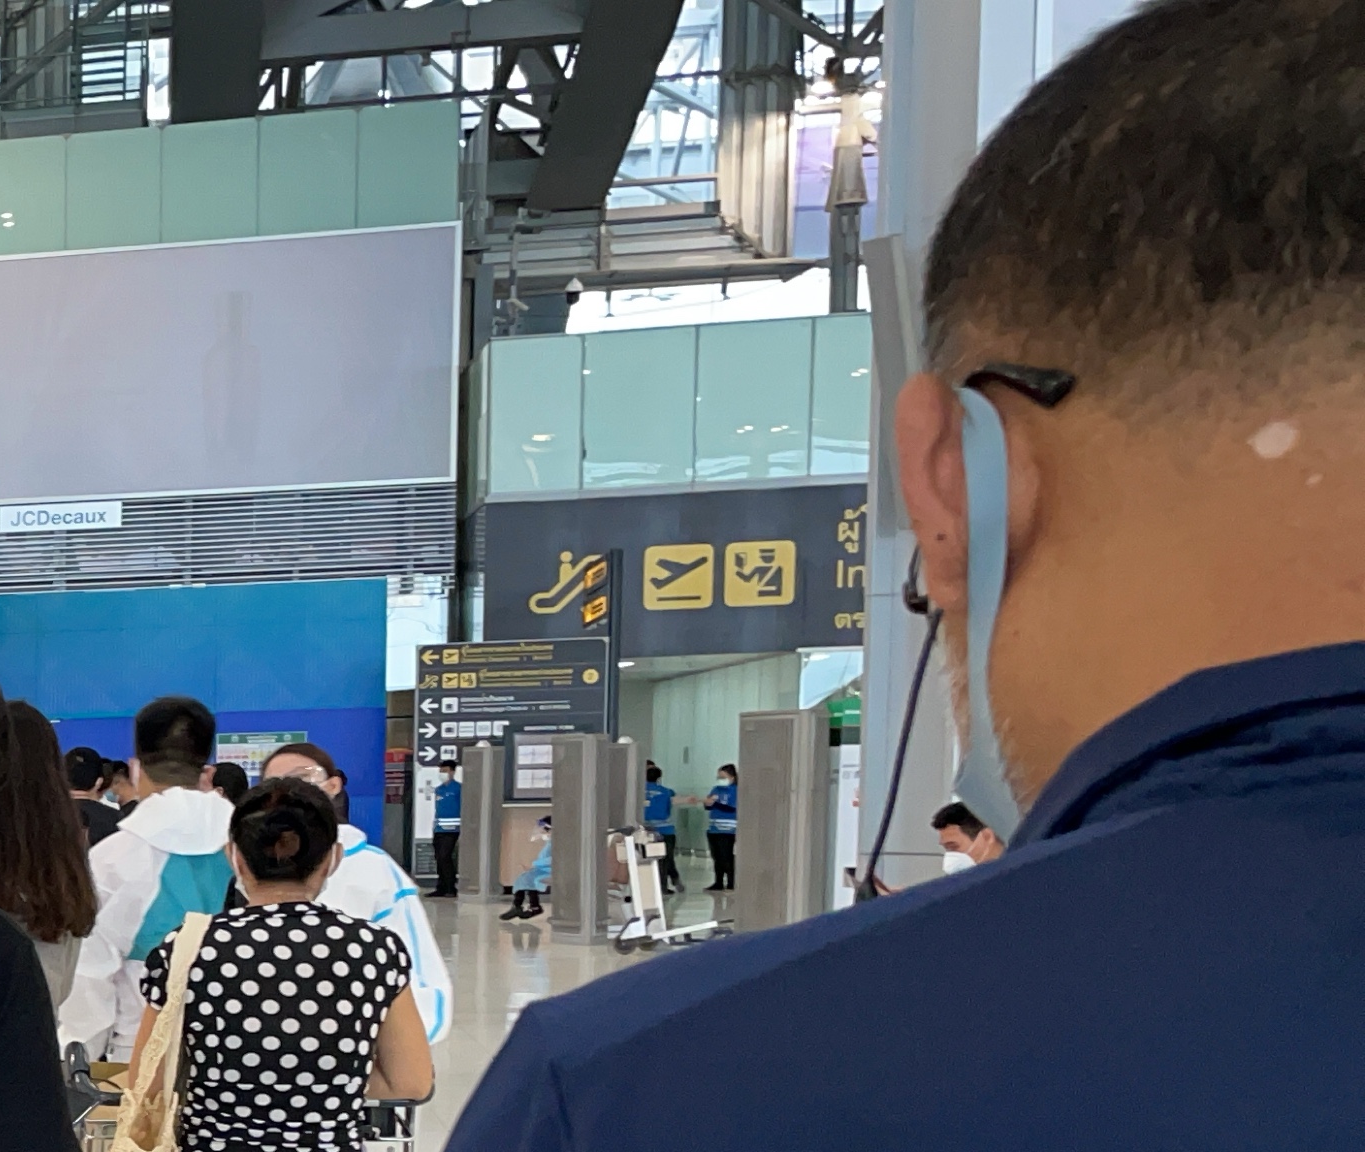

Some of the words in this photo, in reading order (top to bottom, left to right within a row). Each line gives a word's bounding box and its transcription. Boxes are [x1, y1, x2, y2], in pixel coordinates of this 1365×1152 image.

[10, 510, 107, 526] JCDecaux
[837, 503, 868, 553] ผู้
[836, 559, 866, 588] In
